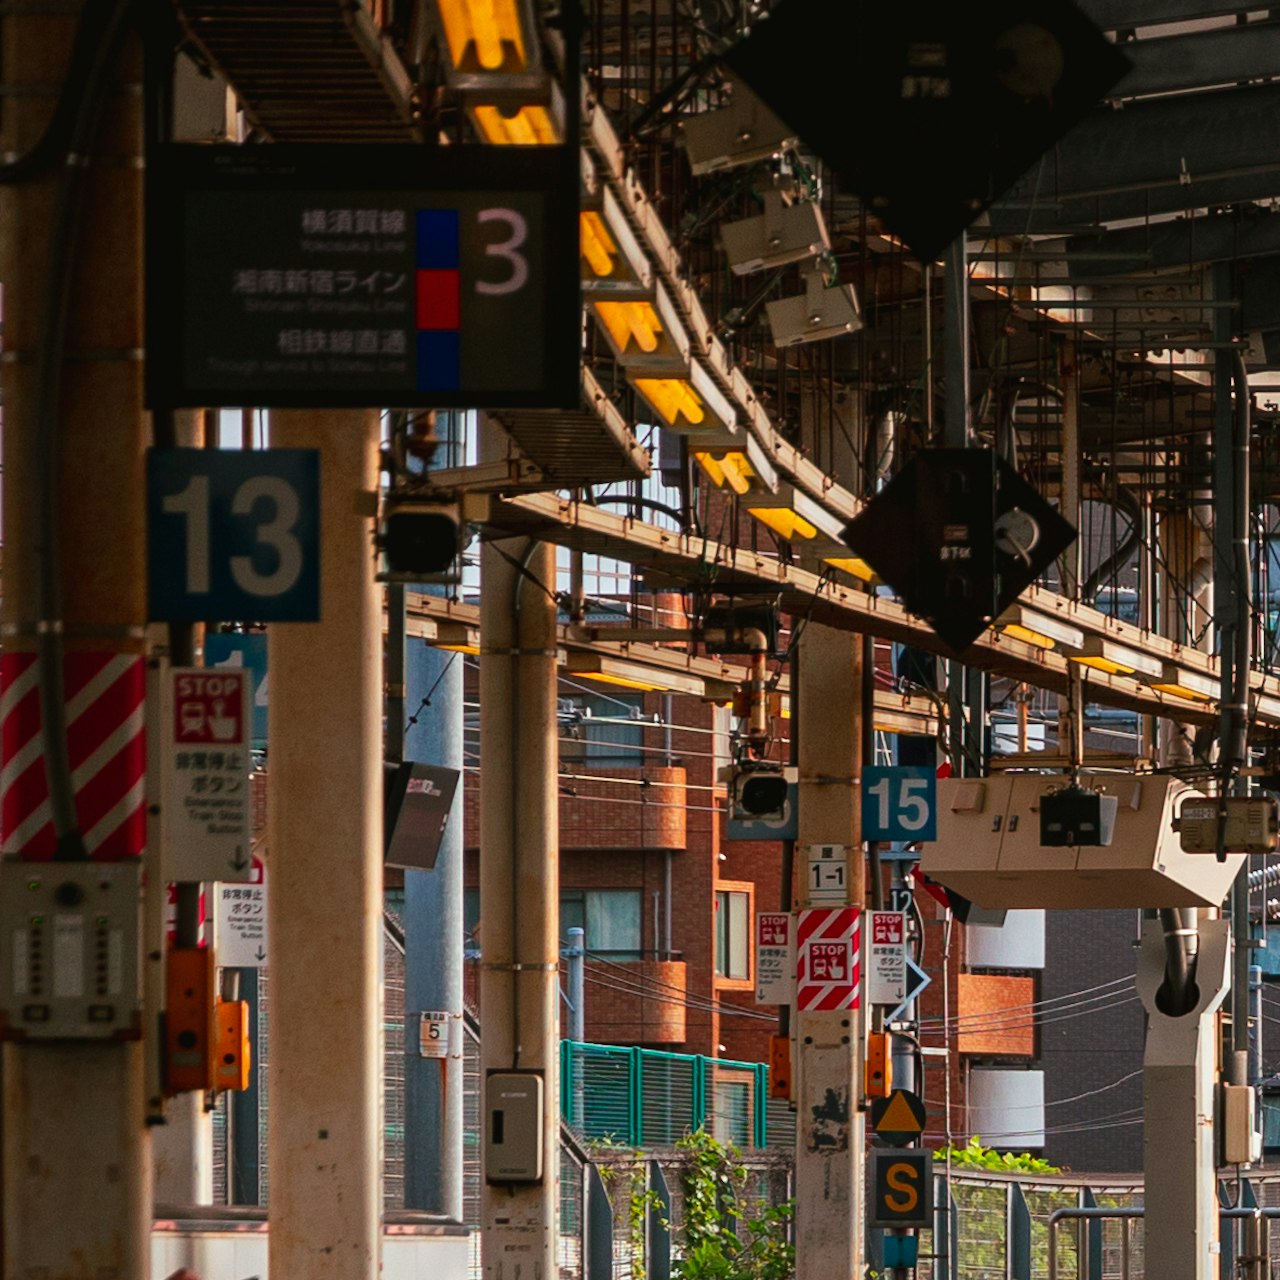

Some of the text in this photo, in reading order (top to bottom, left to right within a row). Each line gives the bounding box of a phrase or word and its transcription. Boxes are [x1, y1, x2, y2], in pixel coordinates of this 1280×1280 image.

[301, 209, 406, 234] 横須賀線
[474, 207, 529, 296] 3
[234, 269, 407, 294] 湘南新宿ライン
[277, 330, 406, 354] 相鉄線直通
[162, 475, 303, 597] 13
[178, 677, 239, 697] STOP
[176, 752, 243, 771] 非常停止
[191, 776, 242, 794] ボタン
[868, 778, 930, 831] 15
[812, 864, 844, 888] 1-1
[223, 889, 263, 901] 非常停止
[232, 903, 263, 914] ボタン
[761, 917, 787, 926] STOP
[874, 915, 902, 924] STOP
[812, 945, 846, 956] STOP
[429, 1023, 440, 1039] 5
[885, 1162, 918, 1213] S
